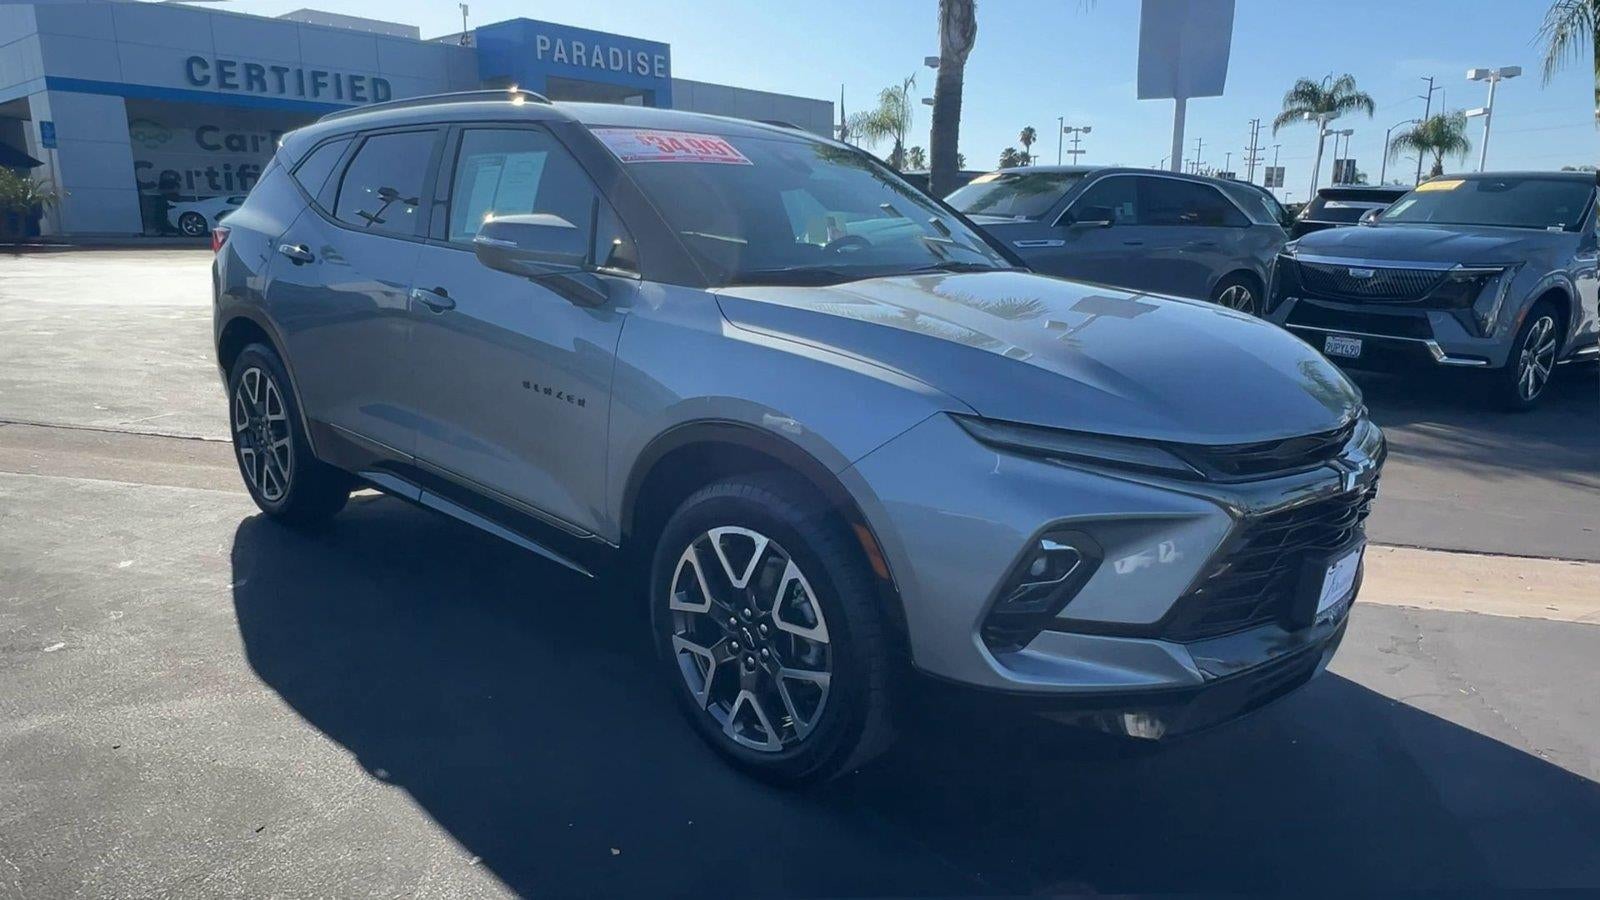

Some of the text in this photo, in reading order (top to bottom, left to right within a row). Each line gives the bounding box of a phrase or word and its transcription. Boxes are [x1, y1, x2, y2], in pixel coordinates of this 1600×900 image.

[536, 34, 666, 78] PARADISE
[186, 56, 392, 103] CERTIFIED
[522, 381, 586, 407] BLAZER
